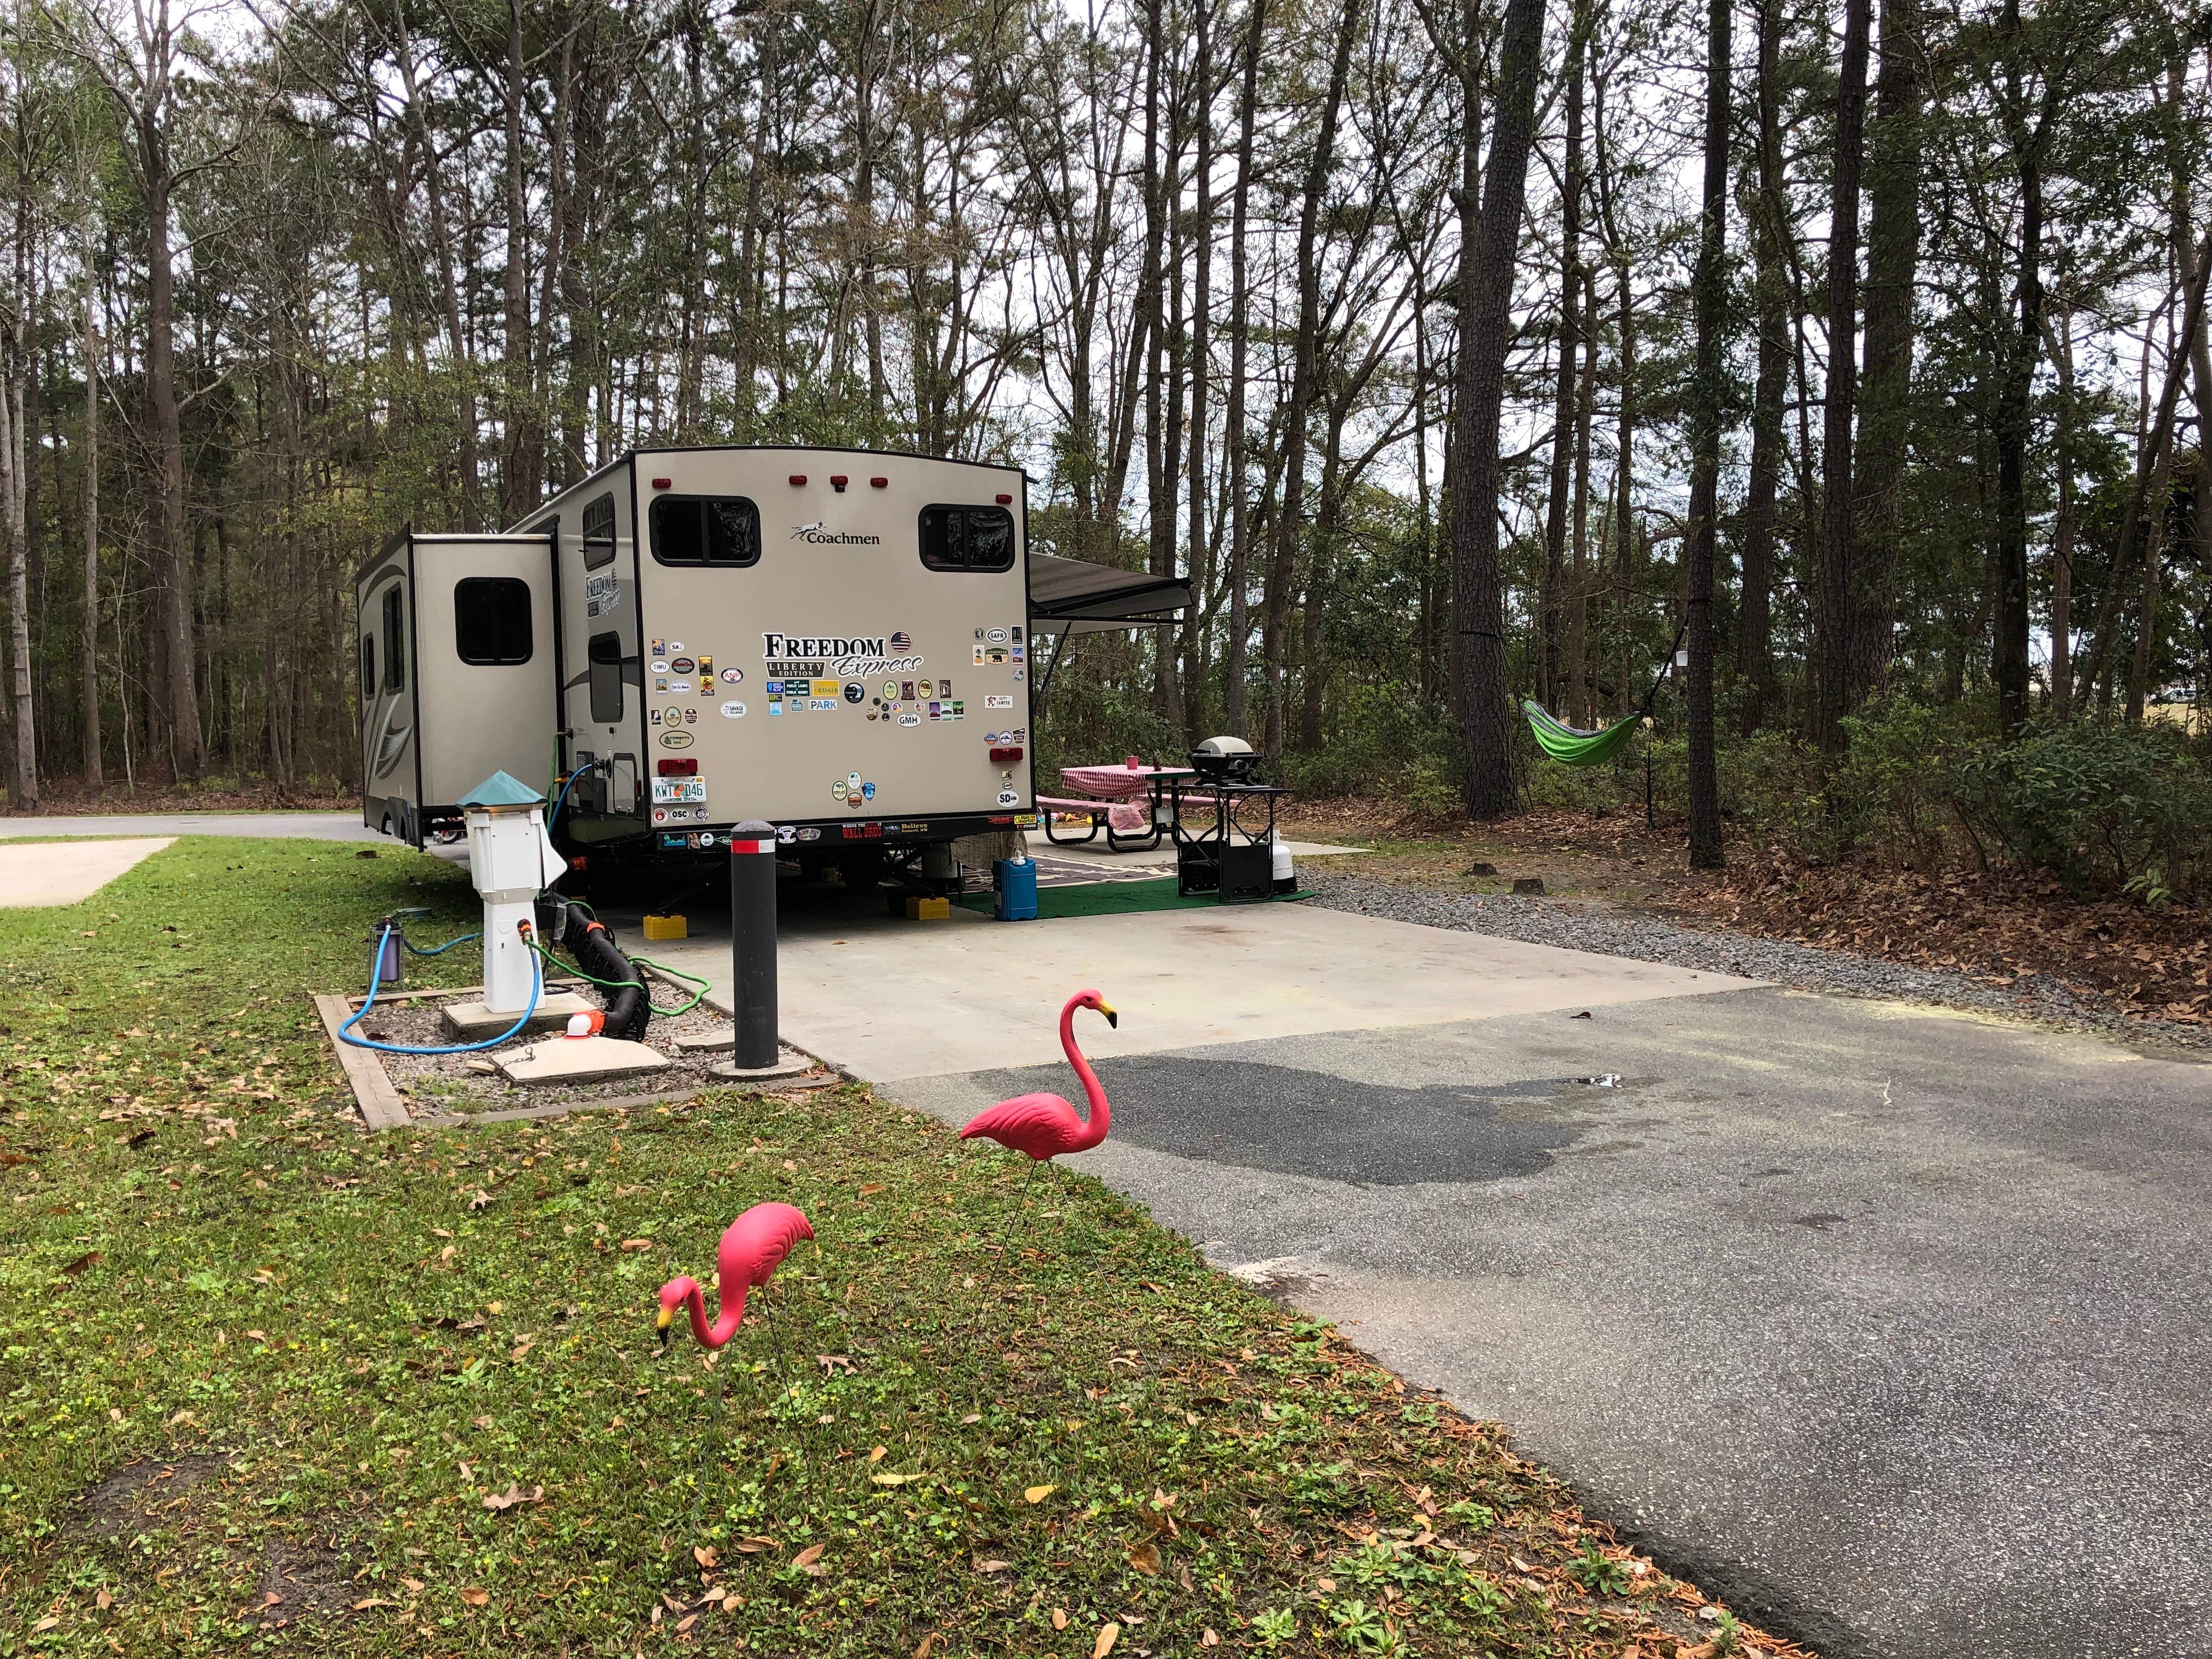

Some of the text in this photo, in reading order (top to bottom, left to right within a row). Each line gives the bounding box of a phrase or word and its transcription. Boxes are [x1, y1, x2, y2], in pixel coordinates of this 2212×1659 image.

[807, 532, 880, 545] Coachmen
[586, 574, 611, 599] FREEDOM
[764, 634, 885, 657] FREEDOM
[769, 663, 823, 671] LIBERTY
[832, 656, 922, 678] Express
[811, 701, 837, 709] PARK
[655, 783, 703, 797] KWT D46
[1000, 794, 1011, 803] SD
[843, 826, 882, 838] WALL DRUG
